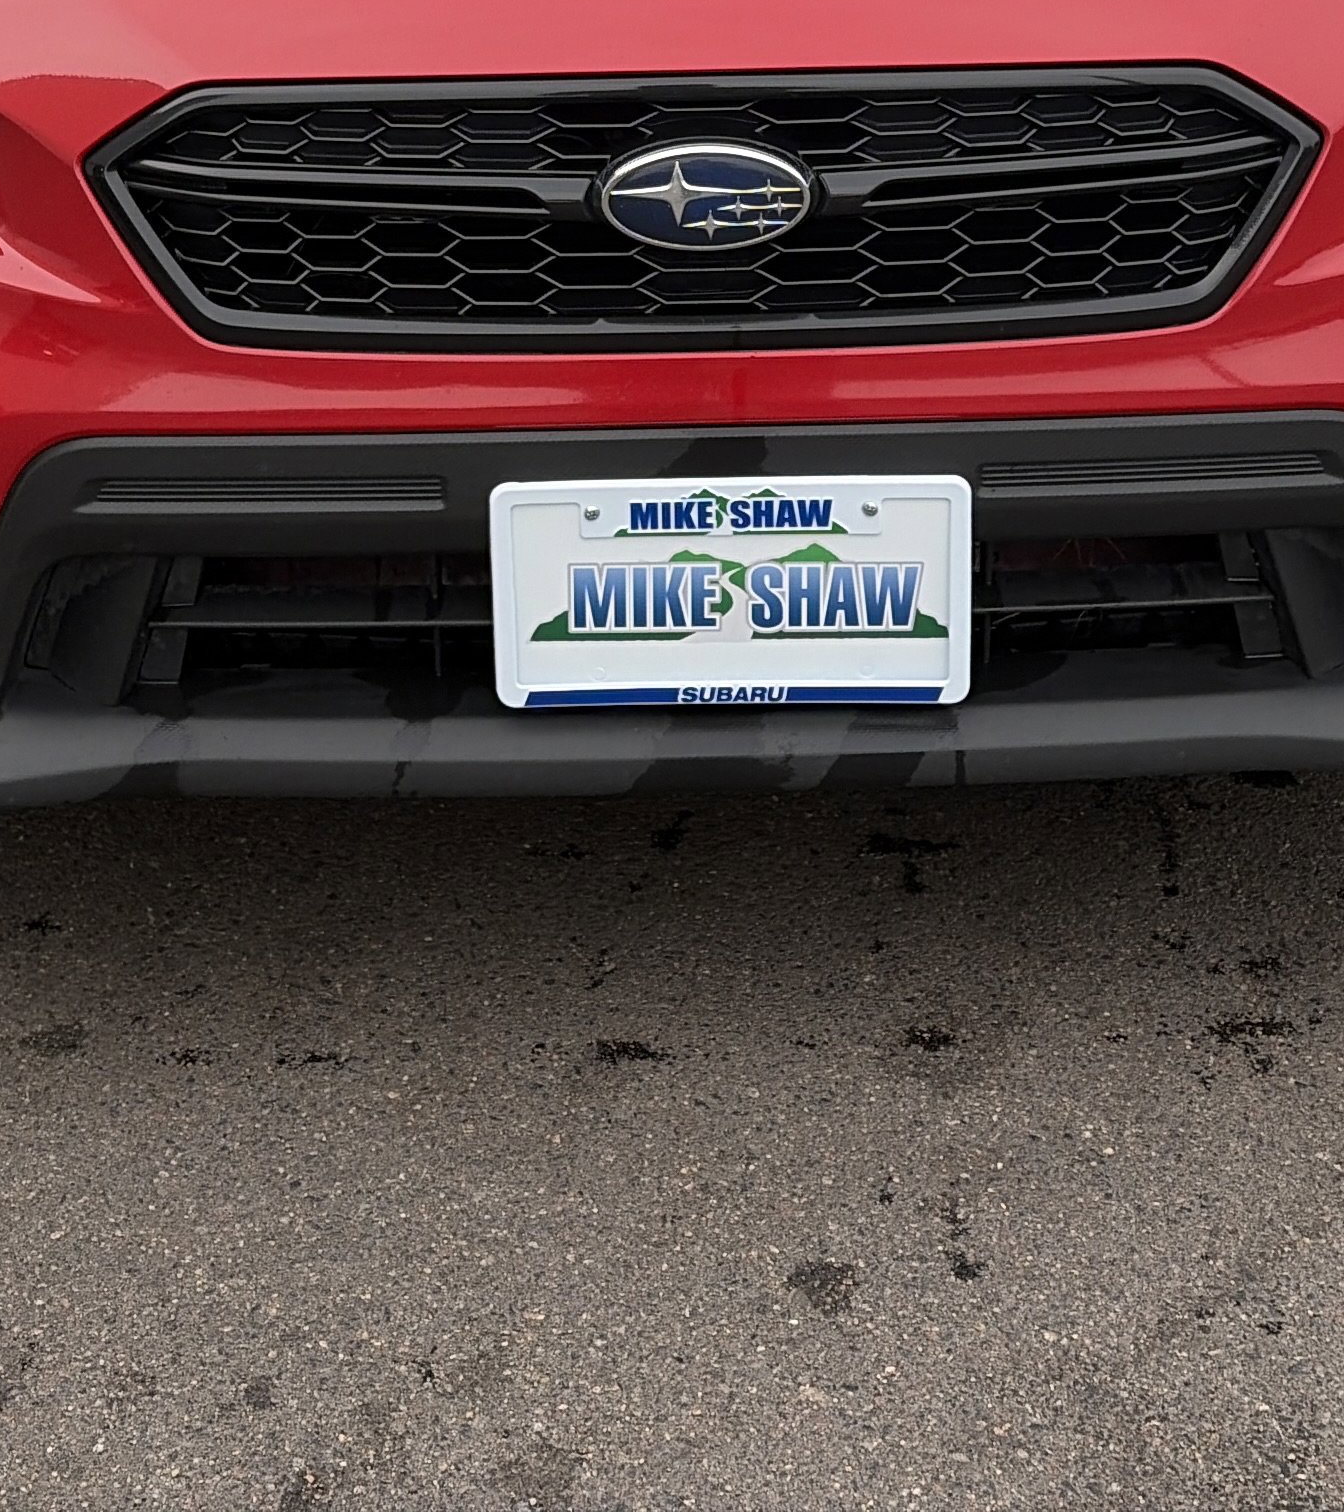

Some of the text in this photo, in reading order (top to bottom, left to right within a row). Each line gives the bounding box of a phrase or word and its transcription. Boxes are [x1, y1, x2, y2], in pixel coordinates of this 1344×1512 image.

[630, 499, 833, 530] MIKE SHAW
[570, 563, 922, 631] MIKE SHAW
[680, 686, 787, 703] SUBARU
